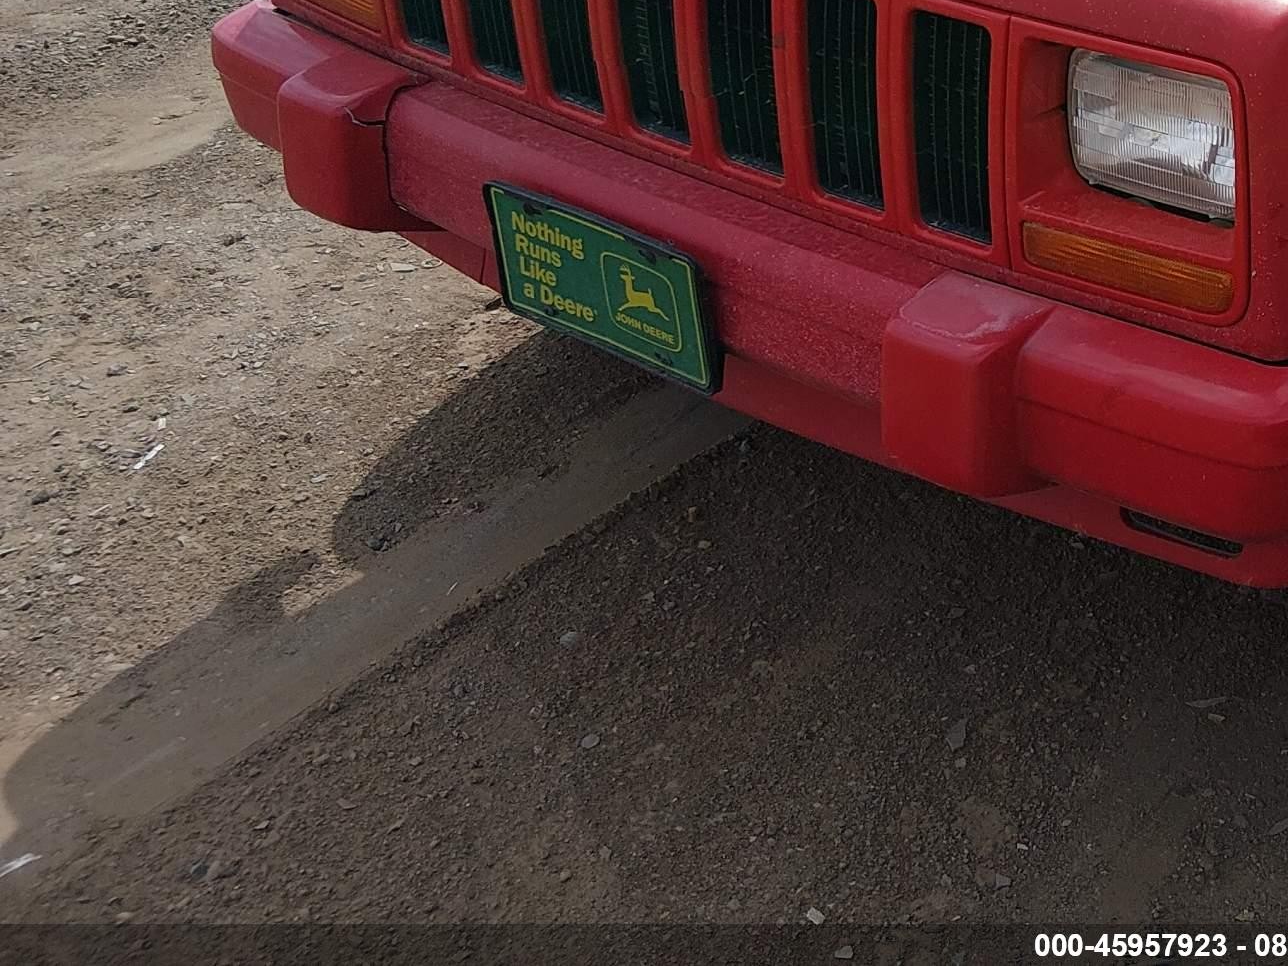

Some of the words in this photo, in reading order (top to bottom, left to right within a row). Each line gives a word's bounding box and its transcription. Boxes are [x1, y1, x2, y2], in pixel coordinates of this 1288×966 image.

[511, 211, 584, 259] Nothing
[515, 233, 562, 268] Runs
[519, 256, 557, 287] Like
[523, 282, 535, 299] a
[540, 284, 596, 323] Deere
[615, 312, 643, 333] JOHN
[642, 322, 675, 345] DEERE
